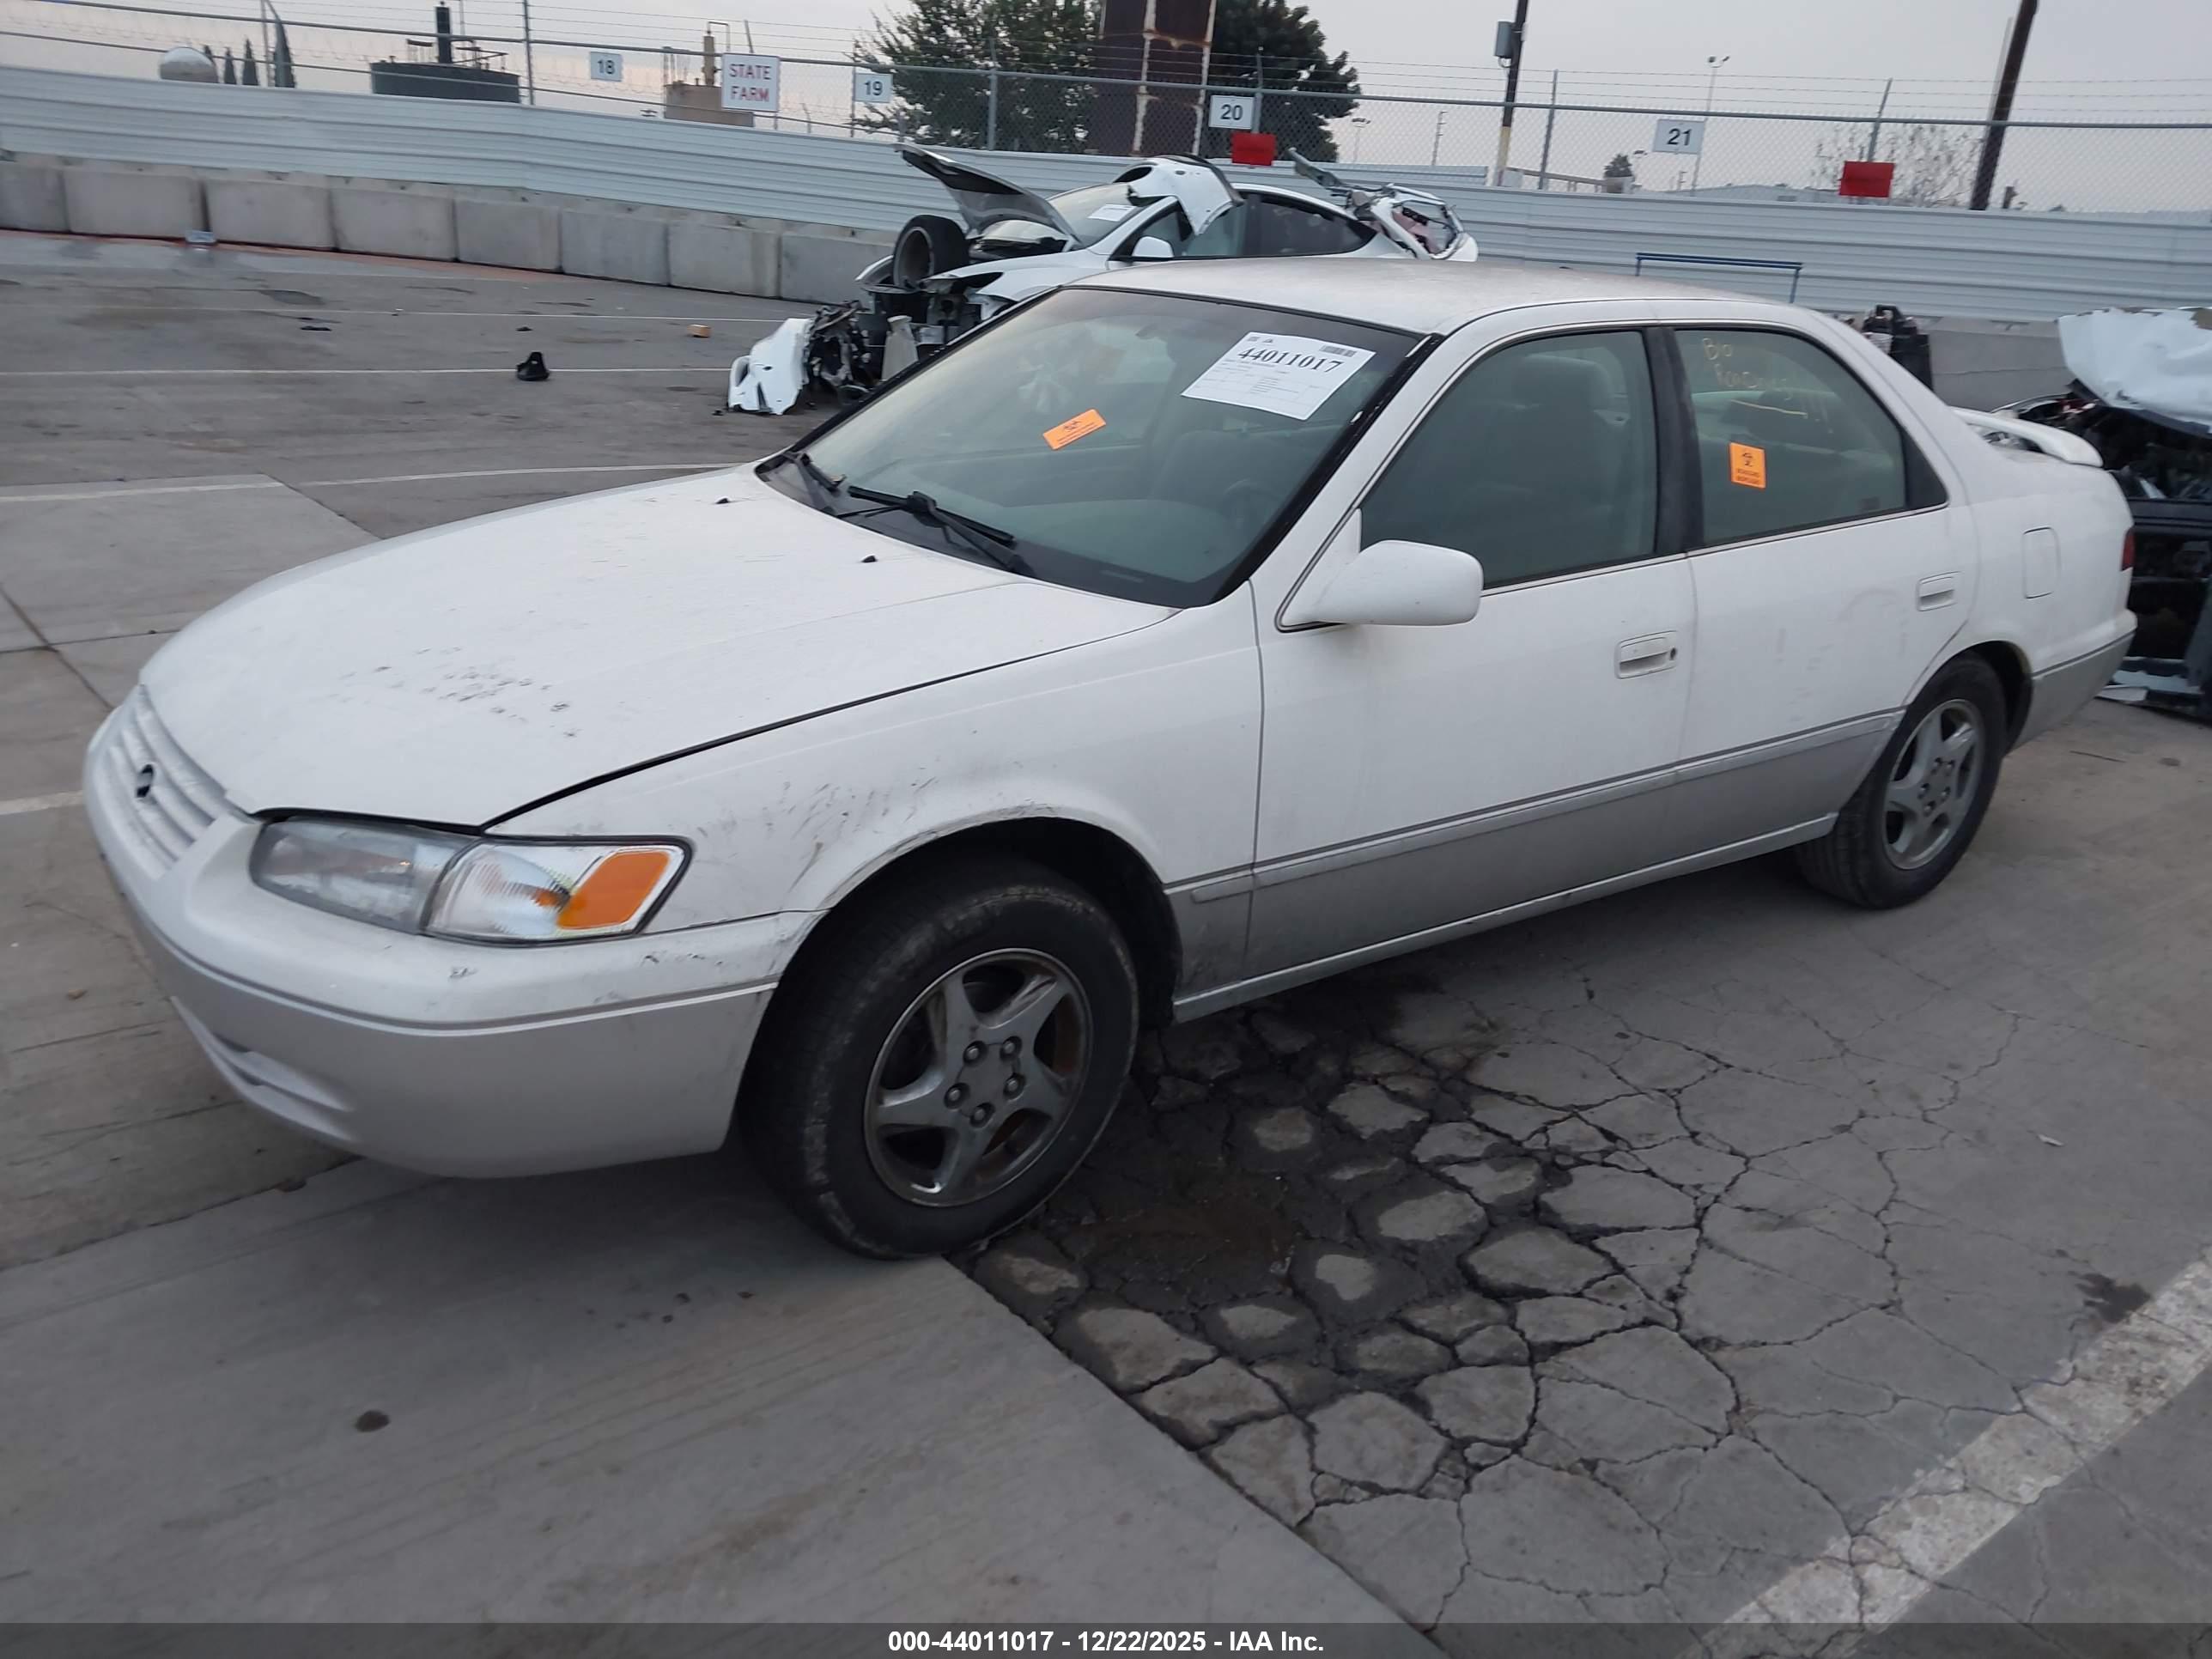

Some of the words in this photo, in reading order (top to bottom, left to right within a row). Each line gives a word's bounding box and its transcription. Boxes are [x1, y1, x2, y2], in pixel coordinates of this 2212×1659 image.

[597, 59, 616, 75] 18
[730, 64, 771, 80] STATE
[731, 86, 769, 102] FARM
[865, 81, 883, 95] 19
[1220, 104, 1243, 120] 20
[1667, 128, 1692, 146] 21
[1237, 346, 1344, 373] 44011017
